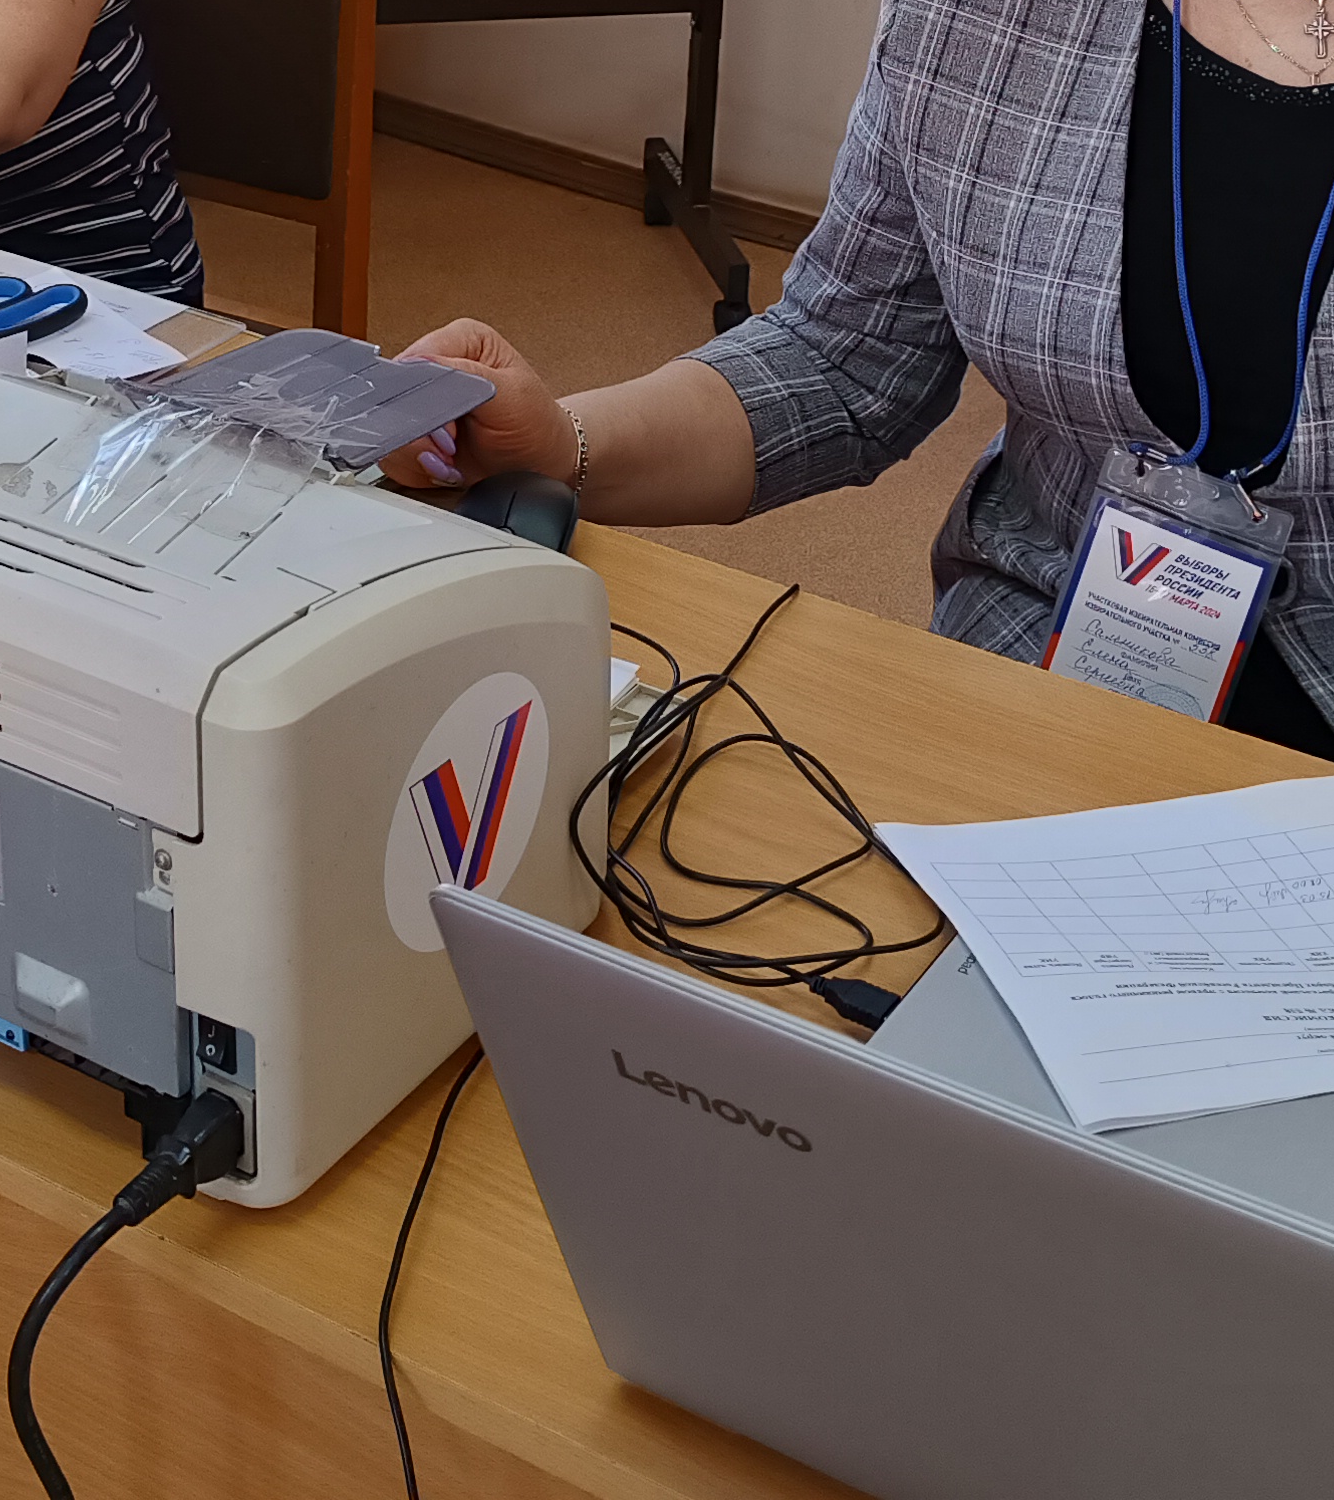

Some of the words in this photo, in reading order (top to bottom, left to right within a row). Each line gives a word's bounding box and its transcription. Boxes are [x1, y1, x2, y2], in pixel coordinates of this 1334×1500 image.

[1164, 564, 1242, 600] ПРЕЗИДЕНТА
[1174, 553, 1231, 581] ВЫБОРЫ
[1154, 574, 1205, 600] РОССИИ
[1084, 600, 1142, 631] ИЗБИРАТЕЛЬНОГО
[1142, 626, 1171, 644] УЧАСТКА
[1088, 591, 1128, 614] УЧАСТКОВАЯ
[1128, 608, 1183, 637] ИЗБИРАТЕЛЬНАЯ
[1183, 631, 1221, 651] КОМИССИЯ
[1169, 594, 1199, 611] МАРТА
[1198, 605, 1221, 619] 2024
[611, 1048, 813, 1153] Lenovo
